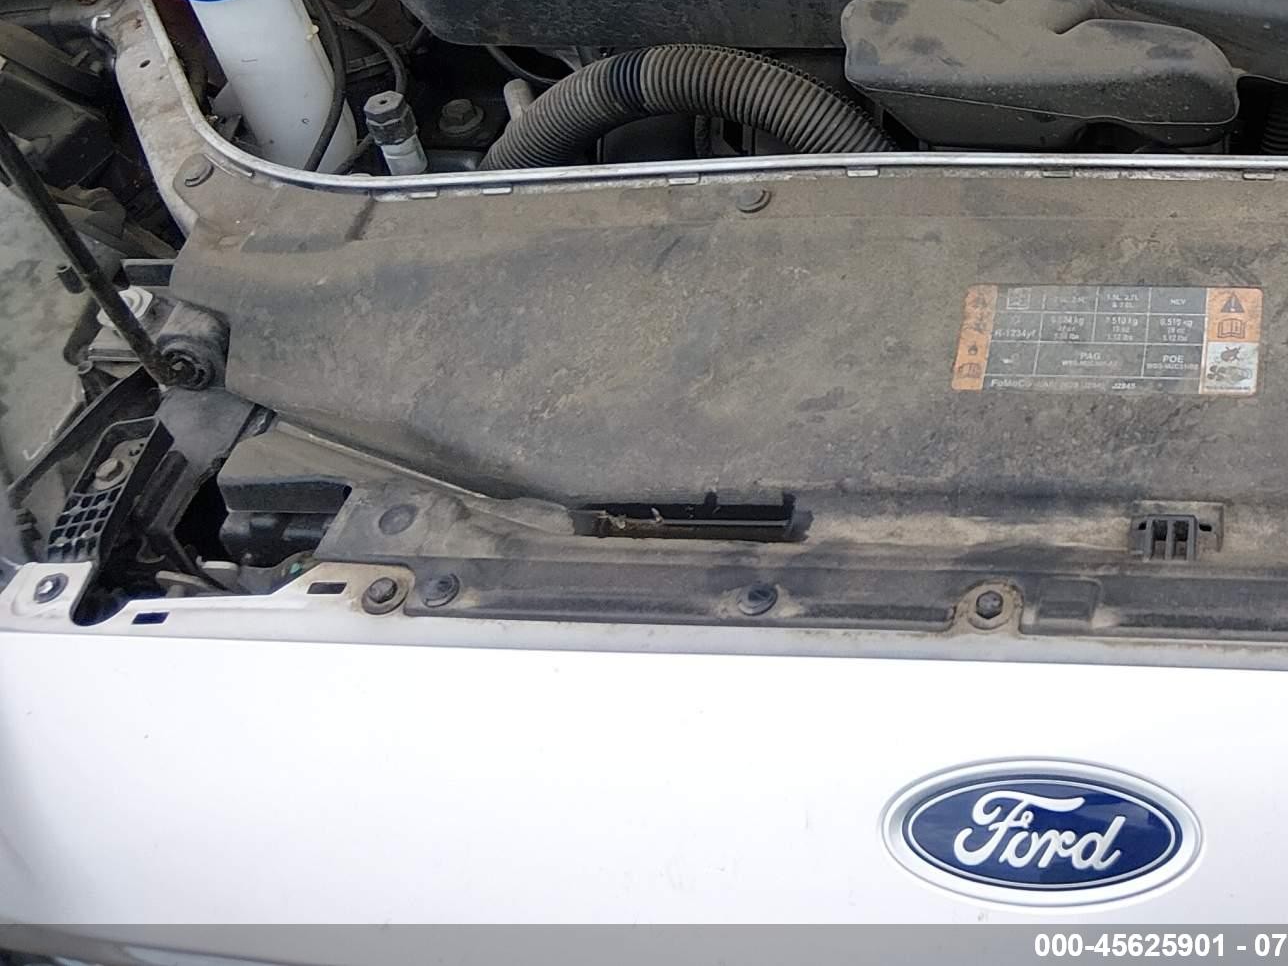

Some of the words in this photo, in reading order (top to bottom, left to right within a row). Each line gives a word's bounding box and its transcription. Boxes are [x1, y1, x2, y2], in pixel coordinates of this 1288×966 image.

[1080, 351, 1101, 360] PAG
[1162, 354, 1185, 363] POE
[953, 790, 1127, 872] Ford
